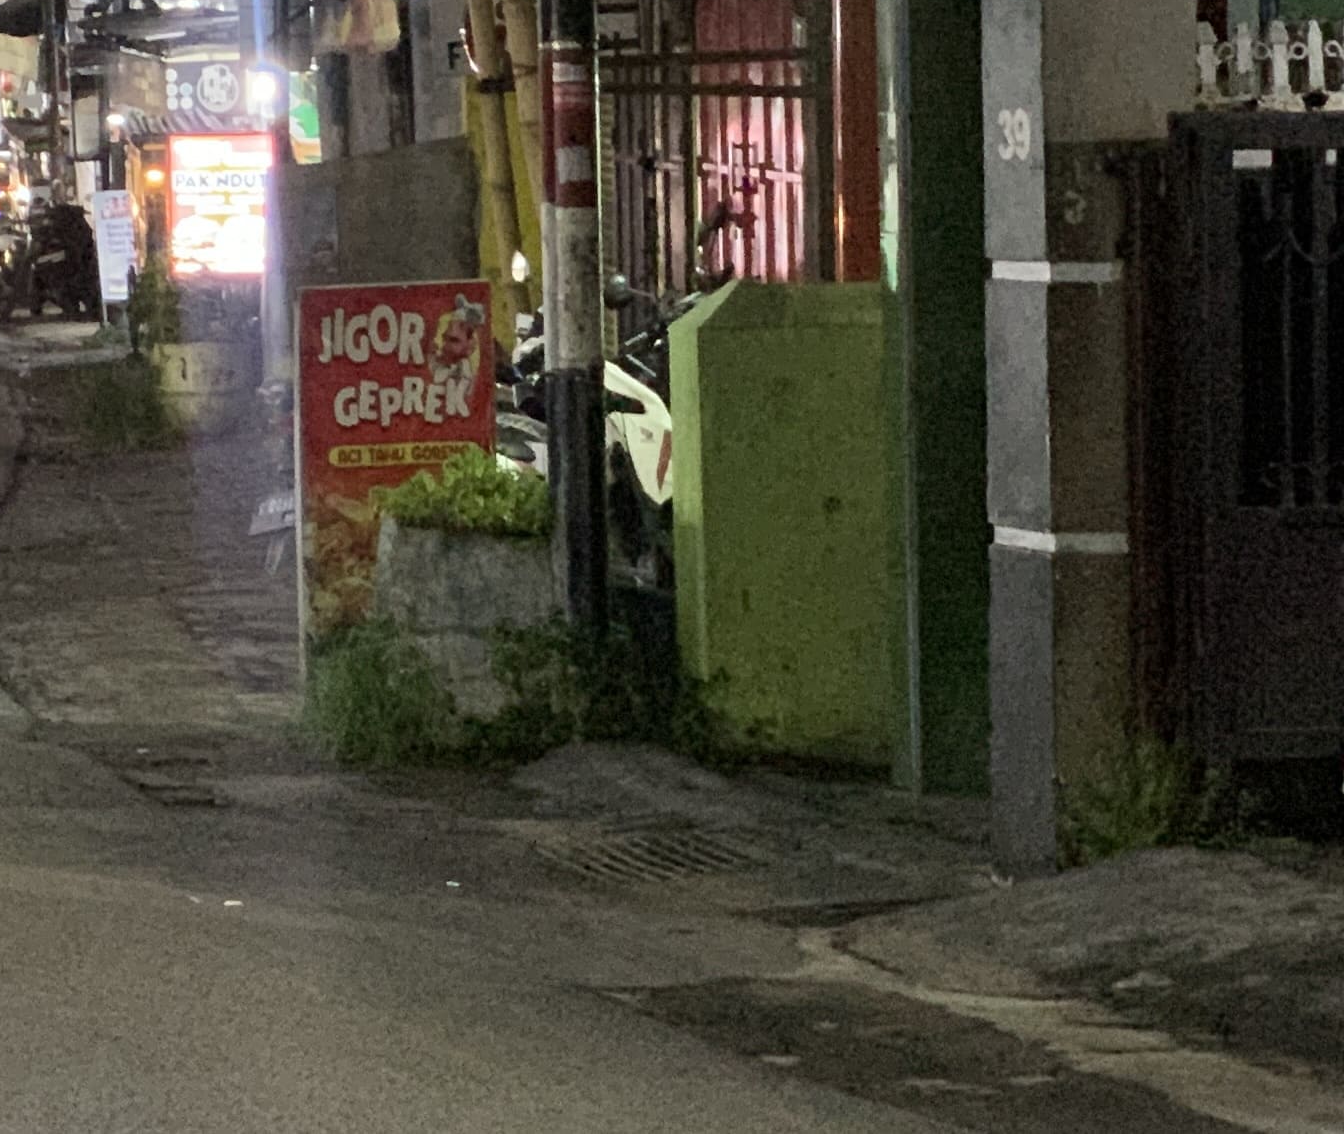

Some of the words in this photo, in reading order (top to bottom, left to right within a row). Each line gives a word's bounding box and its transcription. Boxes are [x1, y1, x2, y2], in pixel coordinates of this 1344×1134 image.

[997, 108, 1031, 161] 39
[175, 173, 209, 188] PAK
[318, 304, 425, 365] JIGOR
[333, 376, 470, 428] GEPREK
